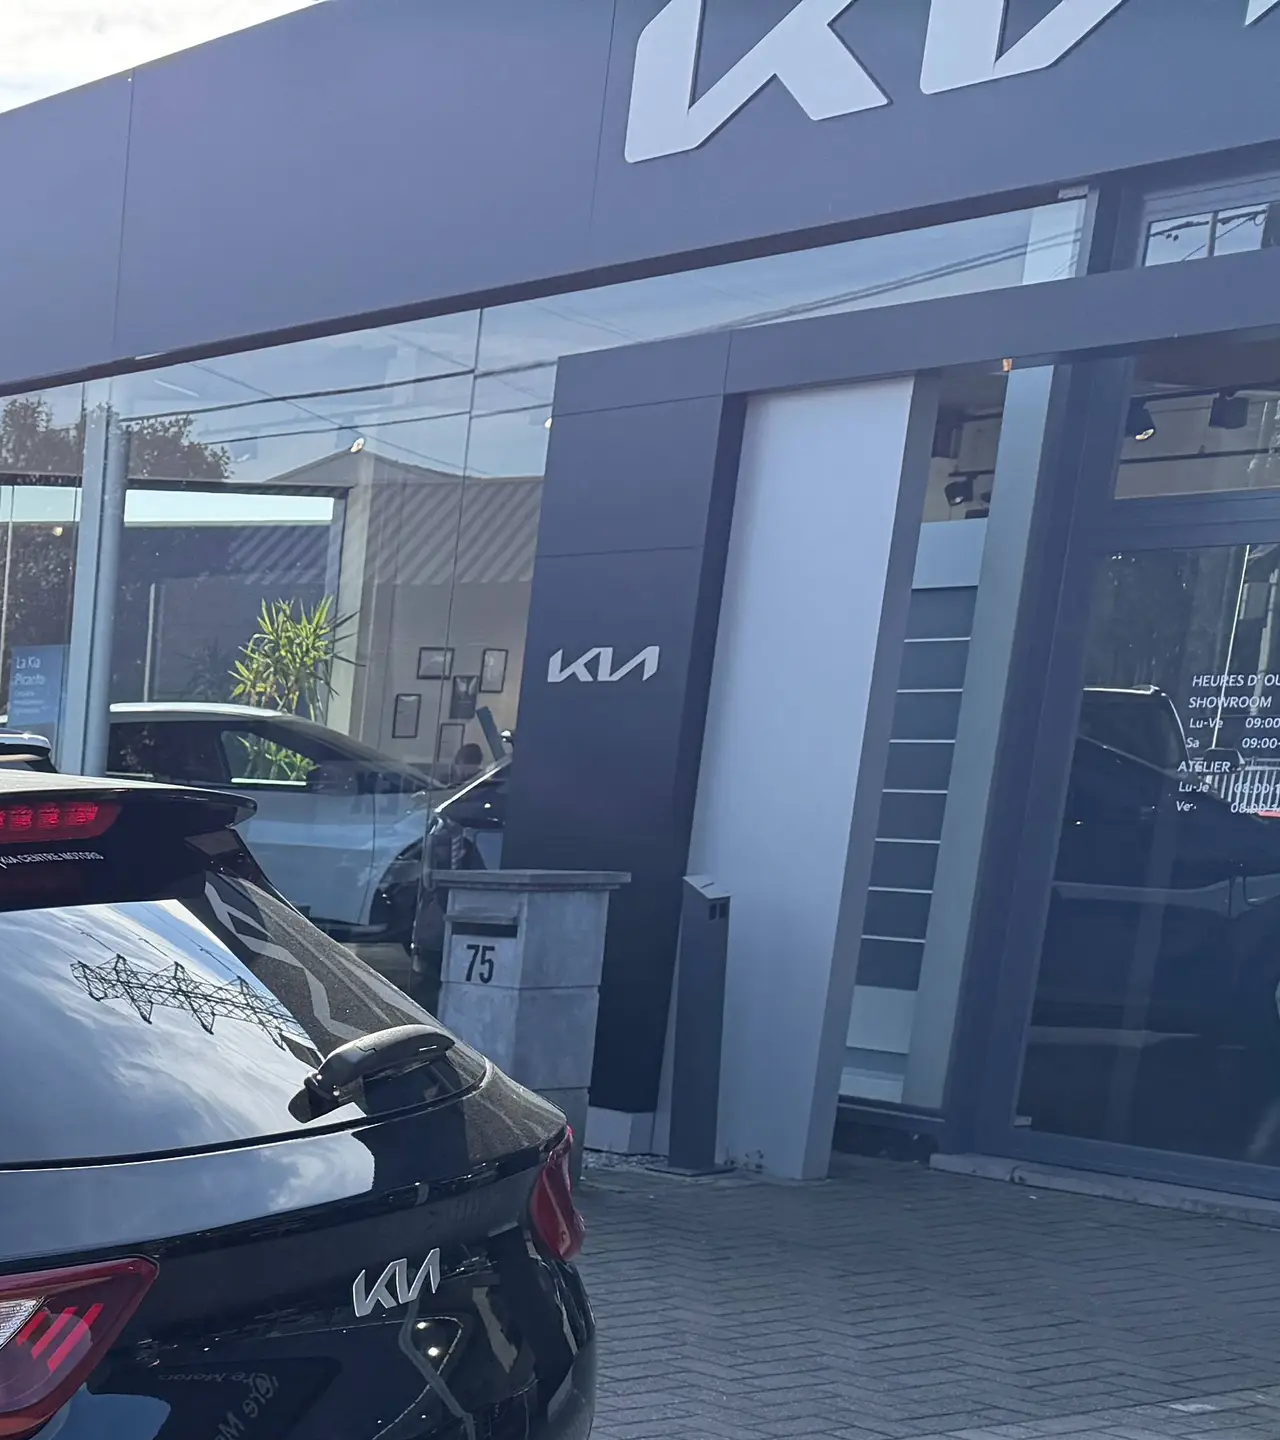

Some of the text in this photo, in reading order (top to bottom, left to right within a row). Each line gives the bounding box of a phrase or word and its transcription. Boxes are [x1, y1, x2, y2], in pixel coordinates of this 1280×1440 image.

[547, 645, 660, 683] KIA
[1192, 675, 1244, 687] HEURES
[1188, 696, 1272, 708] SHOWROOM
[1189, 718, 1224, 729] Lu-Ve
[1186, 738, 1200, 748] Sa
[1177, 761, 1231, 773] ATELIER
[1179, 781, 1209, 793] Lu-Je
[1176, 801, 1191, 811] Ve
[17, 852, 62, 863] CENTRE
[464, 944, 496, 984] 75
[352, 1248, 442, 1318] KIA
